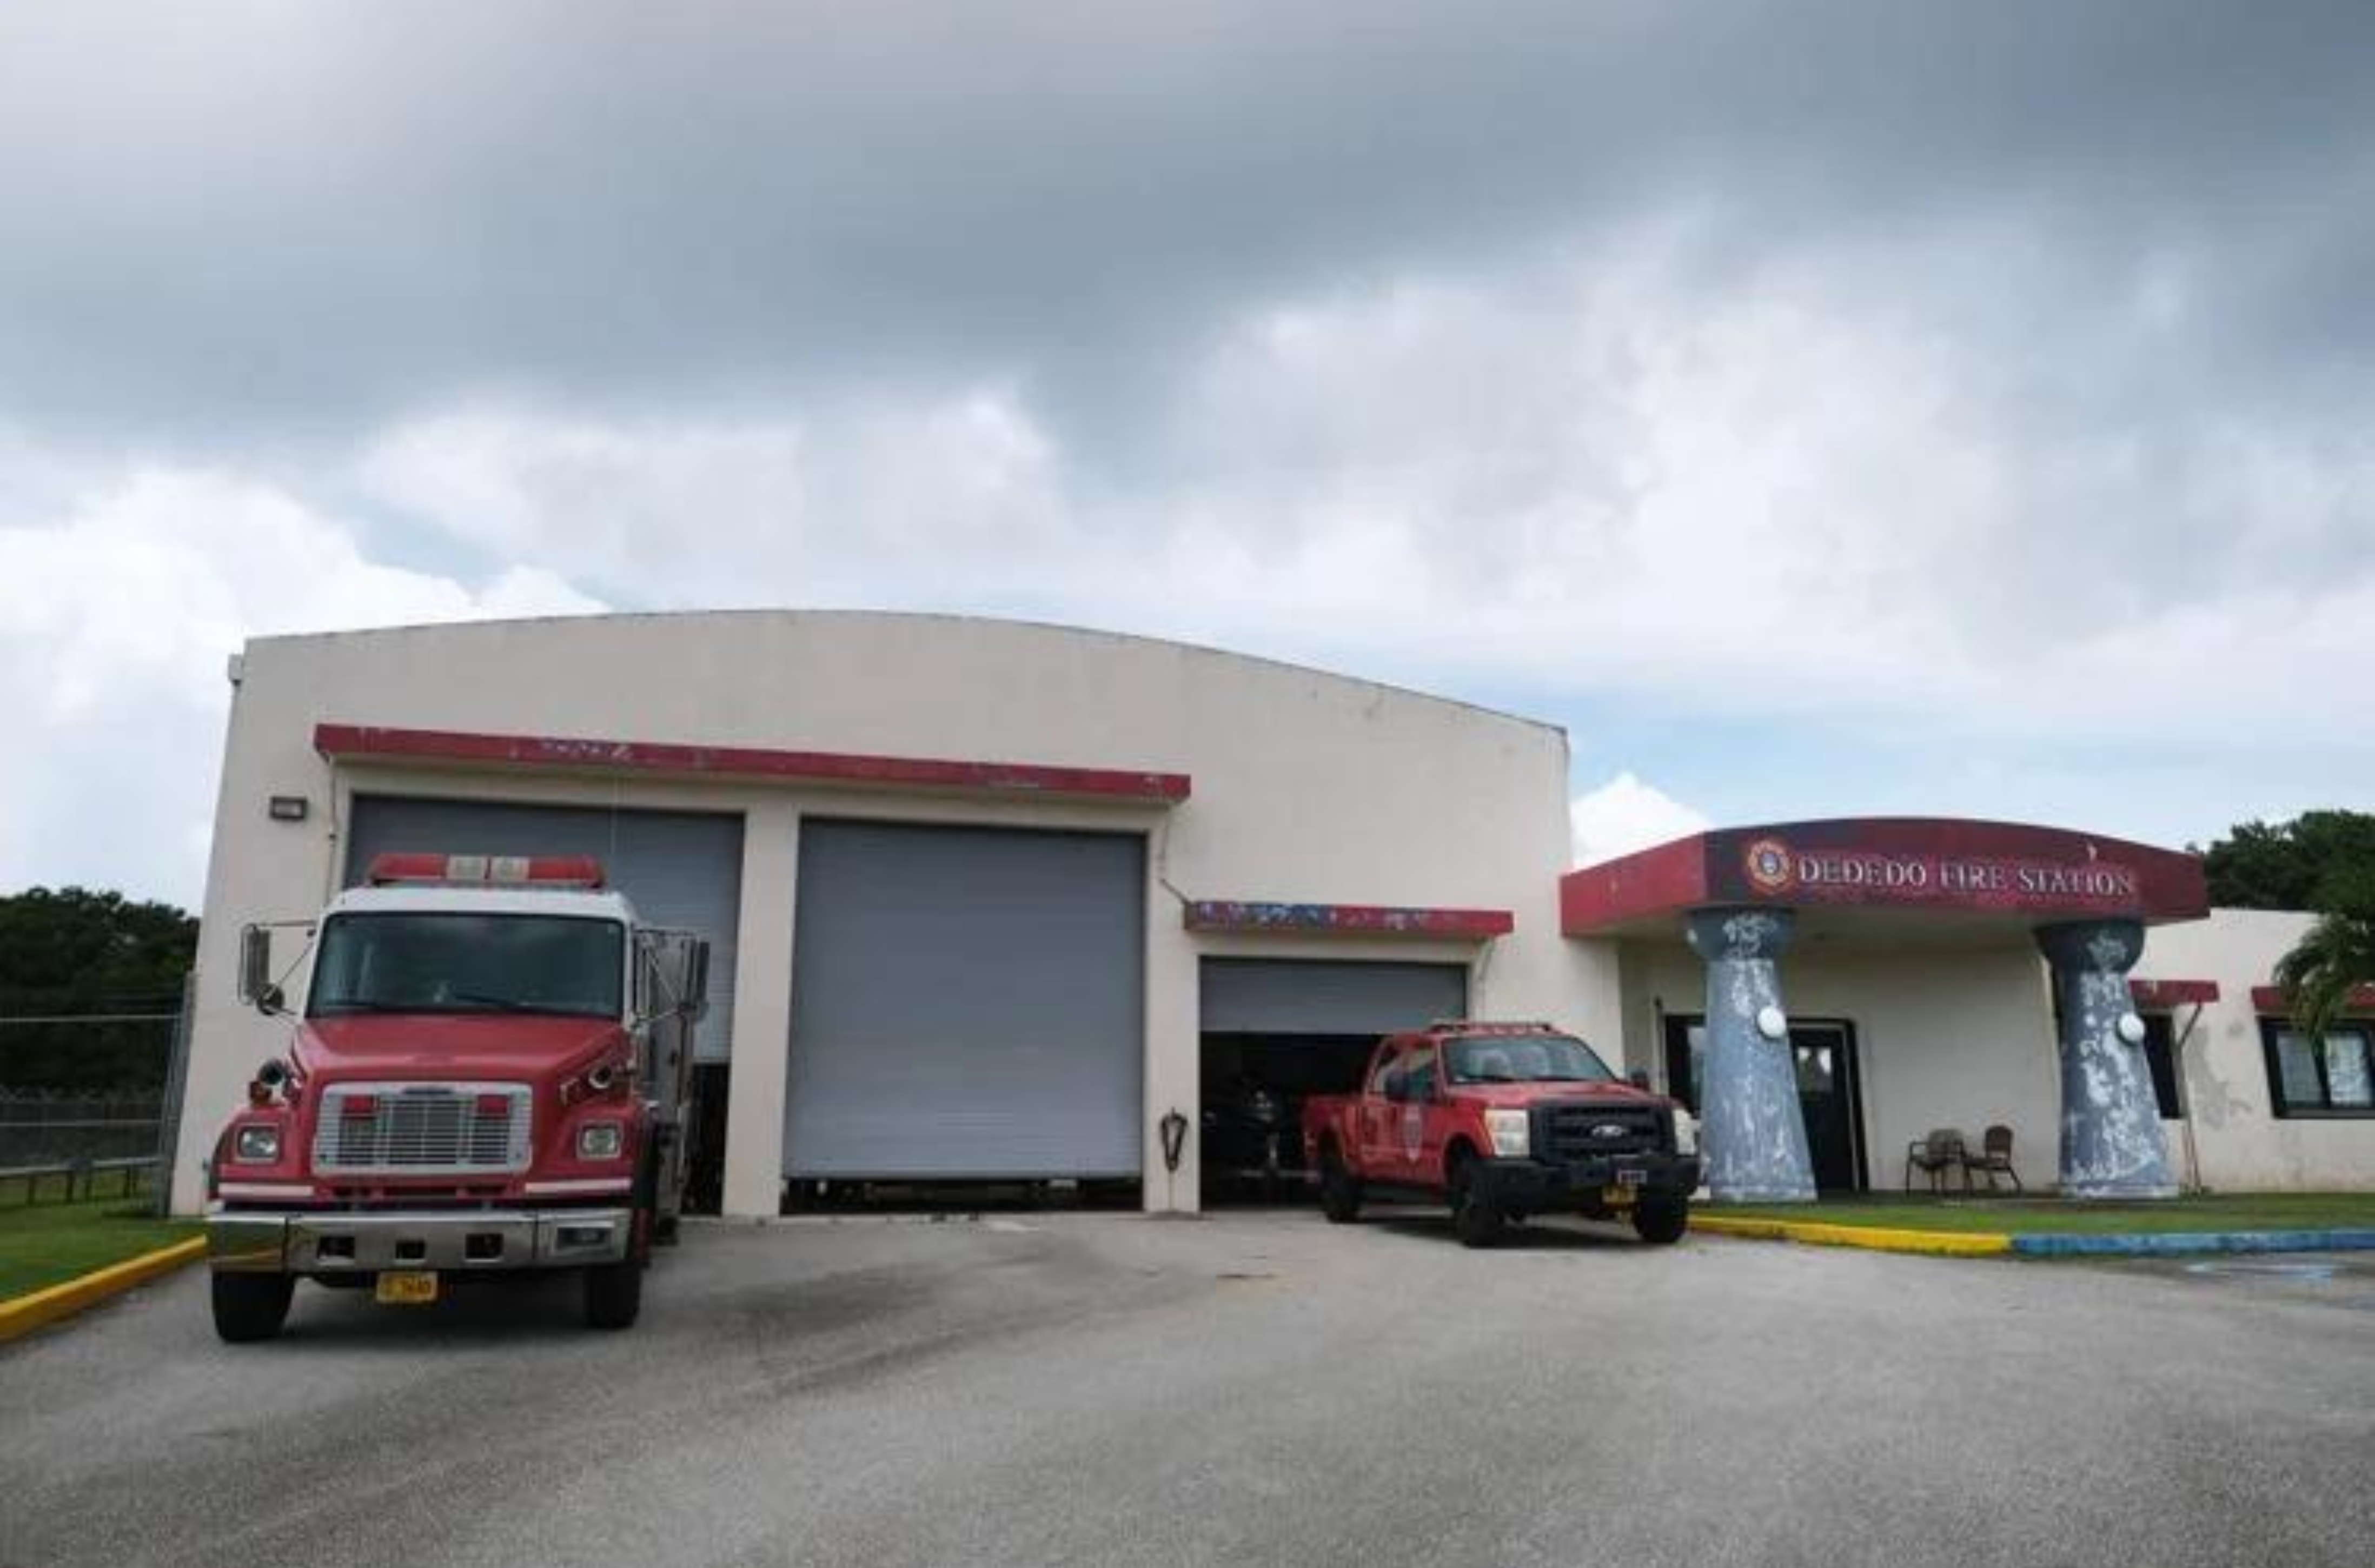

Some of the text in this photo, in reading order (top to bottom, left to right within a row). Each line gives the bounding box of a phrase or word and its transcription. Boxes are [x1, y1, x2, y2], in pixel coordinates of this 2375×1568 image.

[1798, 856, 2133, 895] DEDEDO FIRE STATION
